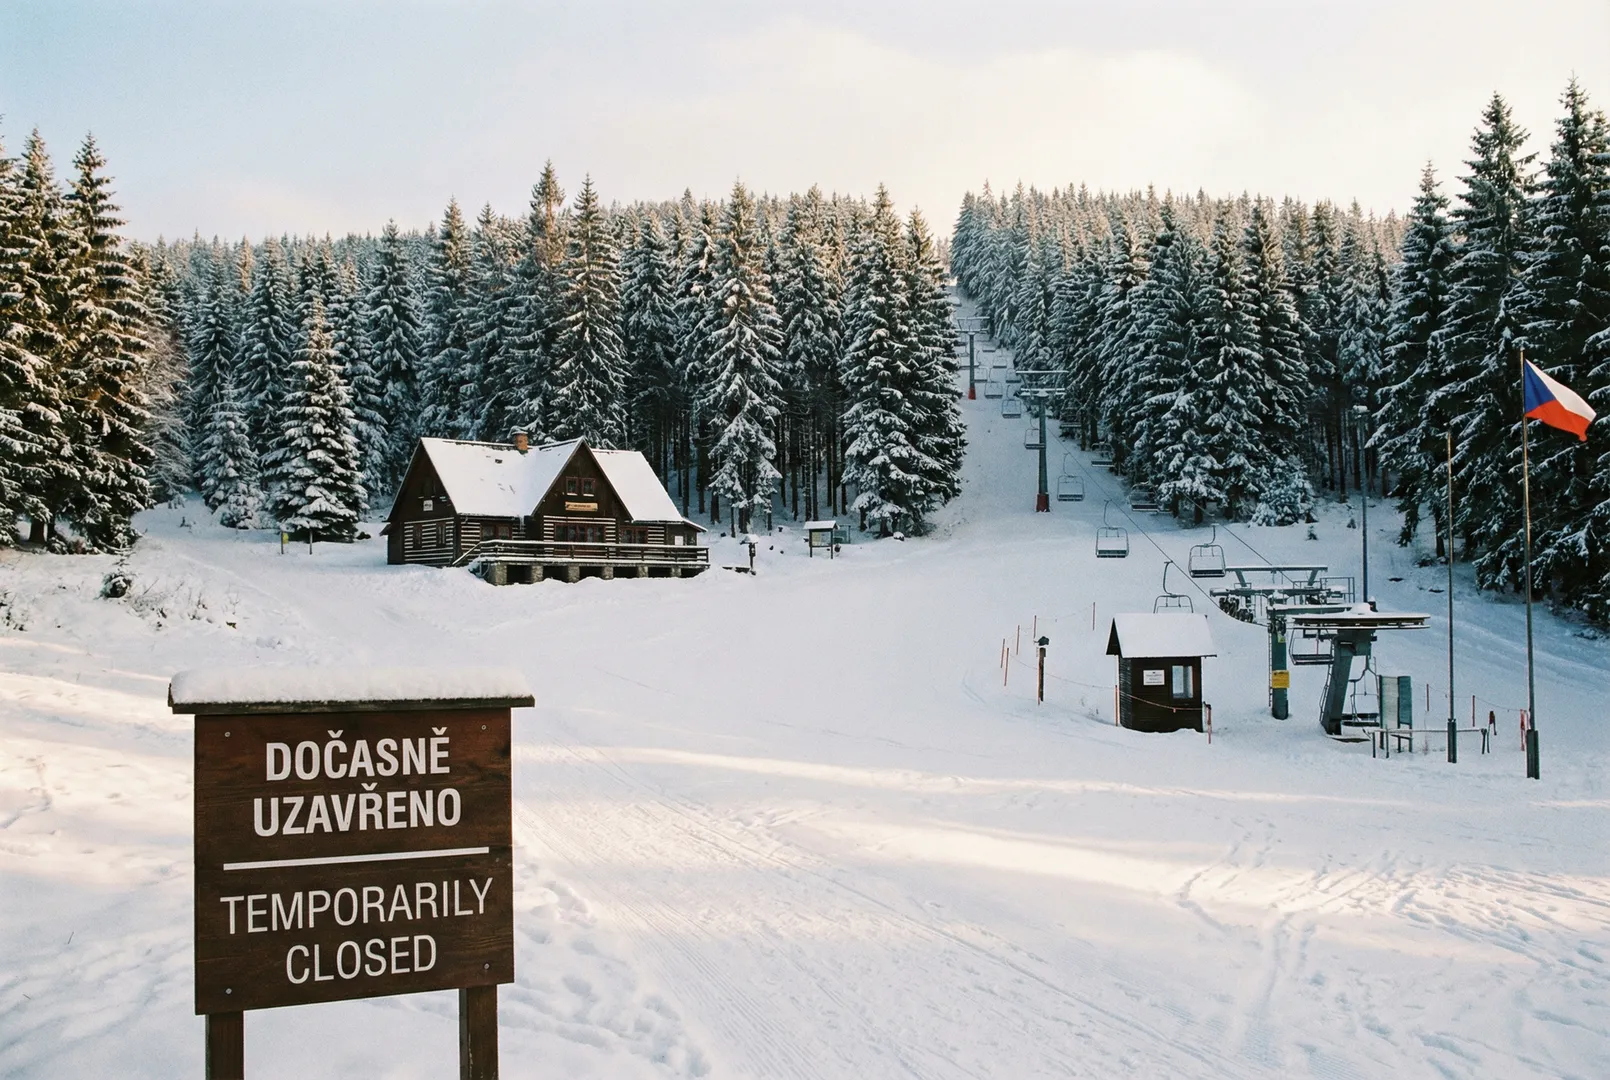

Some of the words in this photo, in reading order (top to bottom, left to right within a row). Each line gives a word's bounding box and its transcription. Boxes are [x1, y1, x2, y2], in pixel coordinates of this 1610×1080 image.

[267, 727, 449, 780] DOČASNĚ
[254, 783, 460, 836] UZAVŘENO
[220, 878, 492, 934] TEMPORARILY
[287, 935, 436, 983] CLOSED
